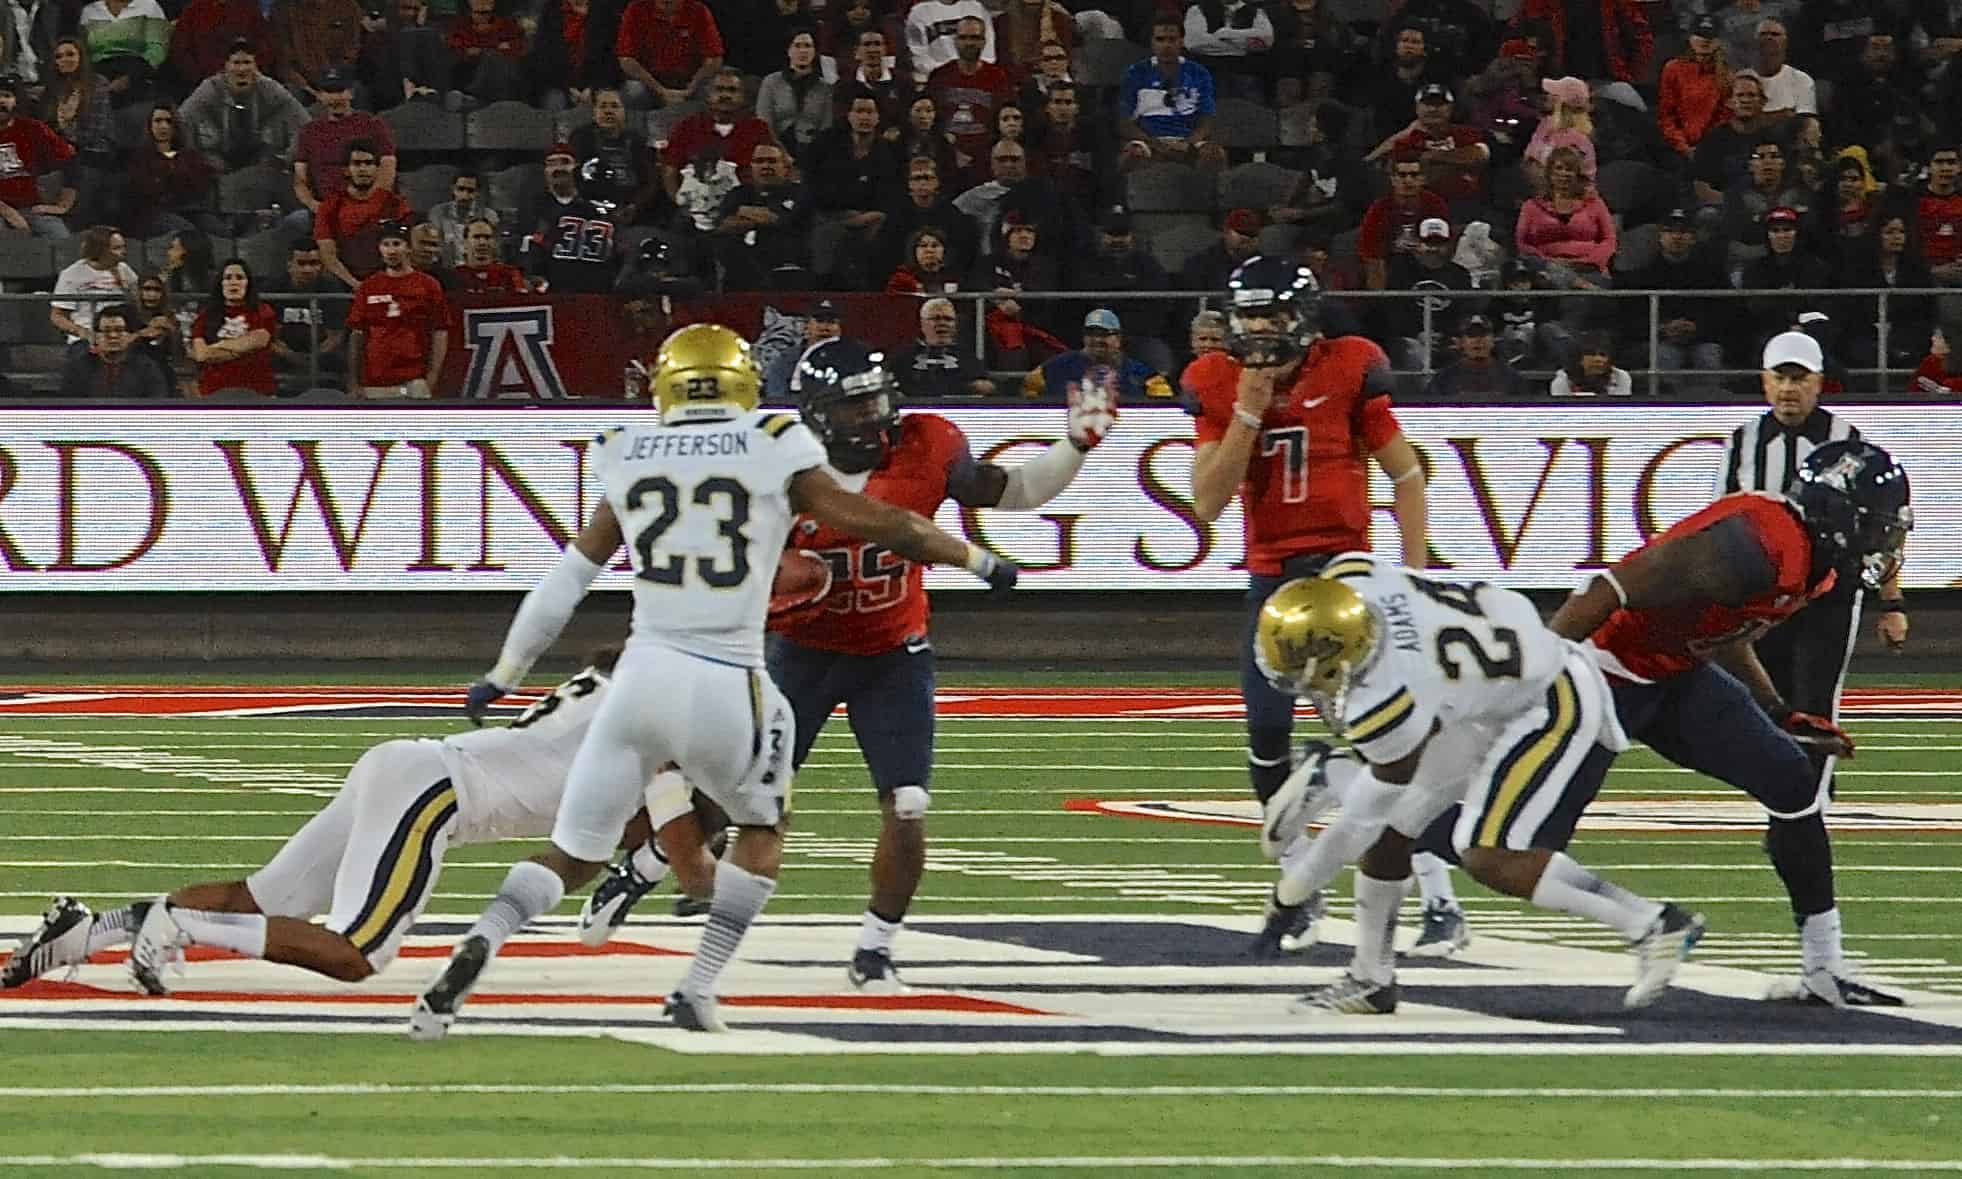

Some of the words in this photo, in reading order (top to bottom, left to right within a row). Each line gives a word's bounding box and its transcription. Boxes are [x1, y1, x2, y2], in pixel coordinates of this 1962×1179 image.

[552, 215, 615, 262] 33
[686, 377, 720, 401] 23
[624, 431, 749, 461] JEFFERSON
[1261, 425, 1310, 503] 7
[626, 475, 752, 590] 23
[1379, 593, 1422, 653] ADAMS
[1405, 574, 1524, 681] 24
